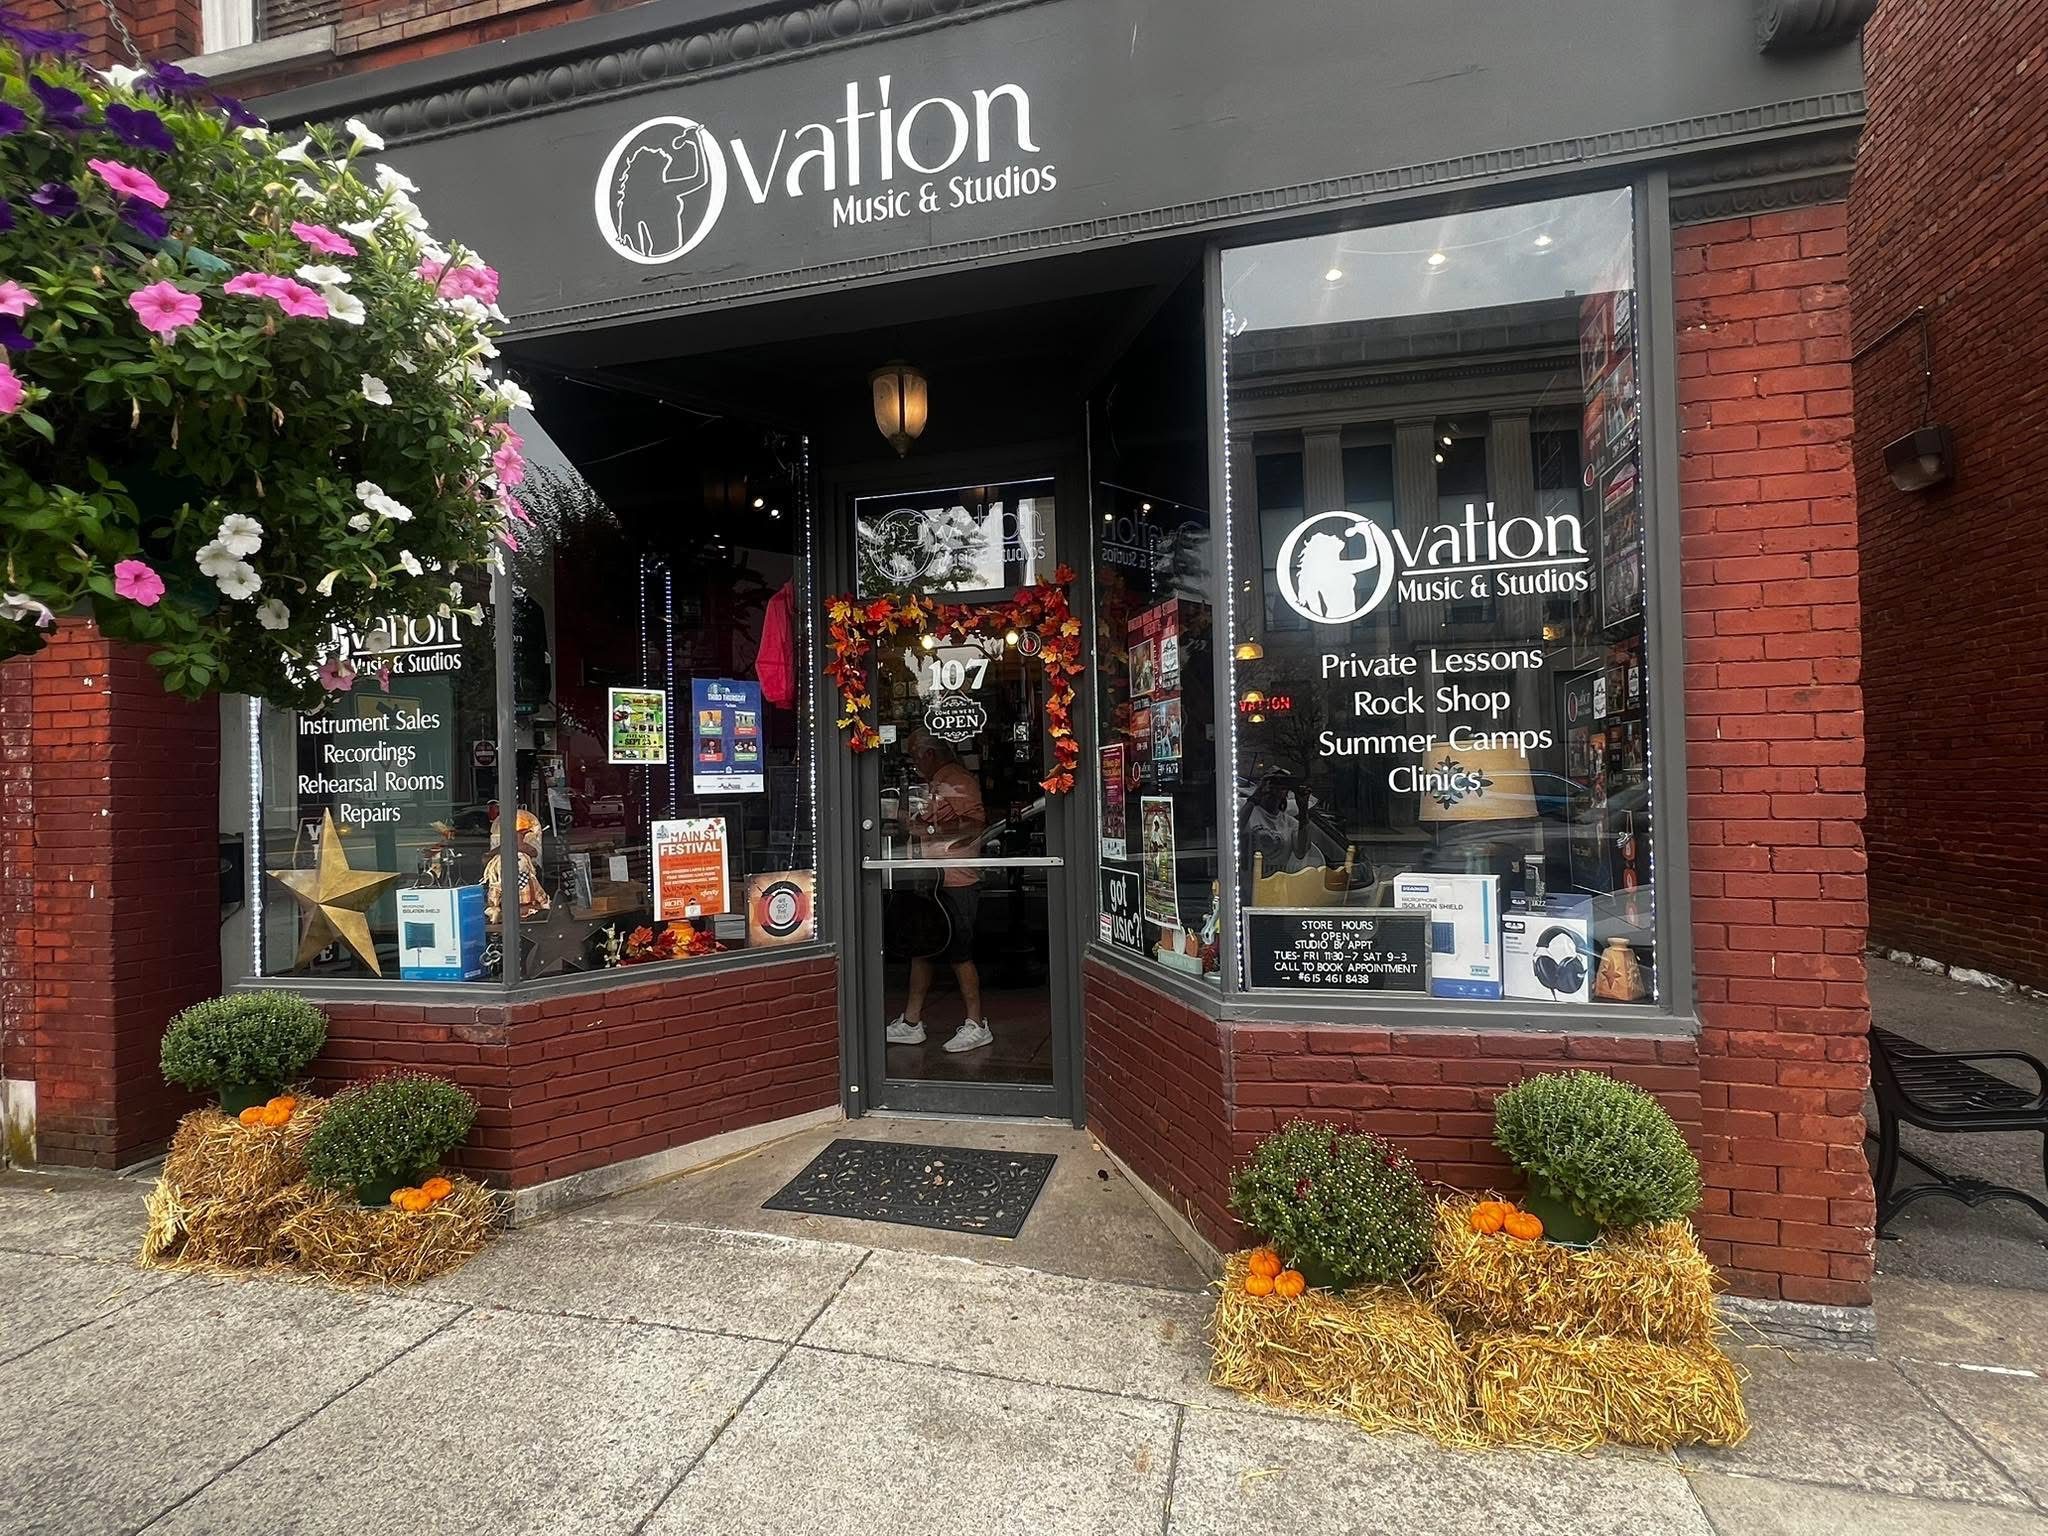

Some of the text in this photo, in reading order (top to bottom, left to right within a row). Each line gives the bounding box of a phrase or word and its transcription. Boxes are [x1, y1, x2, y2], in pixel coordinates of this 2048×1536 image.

[594, 74, 1041, 264] Ovation
[832, 163, 1058, 228] Music & Studios
[1276, 501, 1588, 625] Ovation
[1397, 568, 1590, 604] Music & Studios
[393, 655, 405, 674] &
[408, 652, 462, 674] Studios
[929, 658, 989, 691] 107
[1321, 648, 1544, 680] Private Lessons
[1354, 686, 1511, 719] Rock Shop
[299, 708, 440, 735] Instrument Sales
[932, 715, 979, 729] OPEN
[323, 741, 416, 767] Recordings
[1319, 725, 1553, 758] Summer Camps
[298, 771, 445, 795] Rehearsal Rooms
[1388, 766, 1481, 794] Clinics
[340, 802, 401, 828] Repairs
[660, 841, 721, 857] FESTIVAL
[670, 831, 701, 842] MAIN
[1110, 874, 1127, 911] got
[1111, 909, 1140, 947] usic?
[1301, 921, 1374, 930] STORE HOURS
[1321, 932, 1350, 941] OPEN
[1295, 941, 1373, 950] STUDIO BY APPT
[1303, 951, 1320, 961] FRI
[1363, 952, 1382, 962] SAT
[1274, 962, 1418, 973] CALL TO BOOK APPOINTMENT
[1325, 974, 1342, 983] 461
[1345, 974, 1370, 984] 8438
